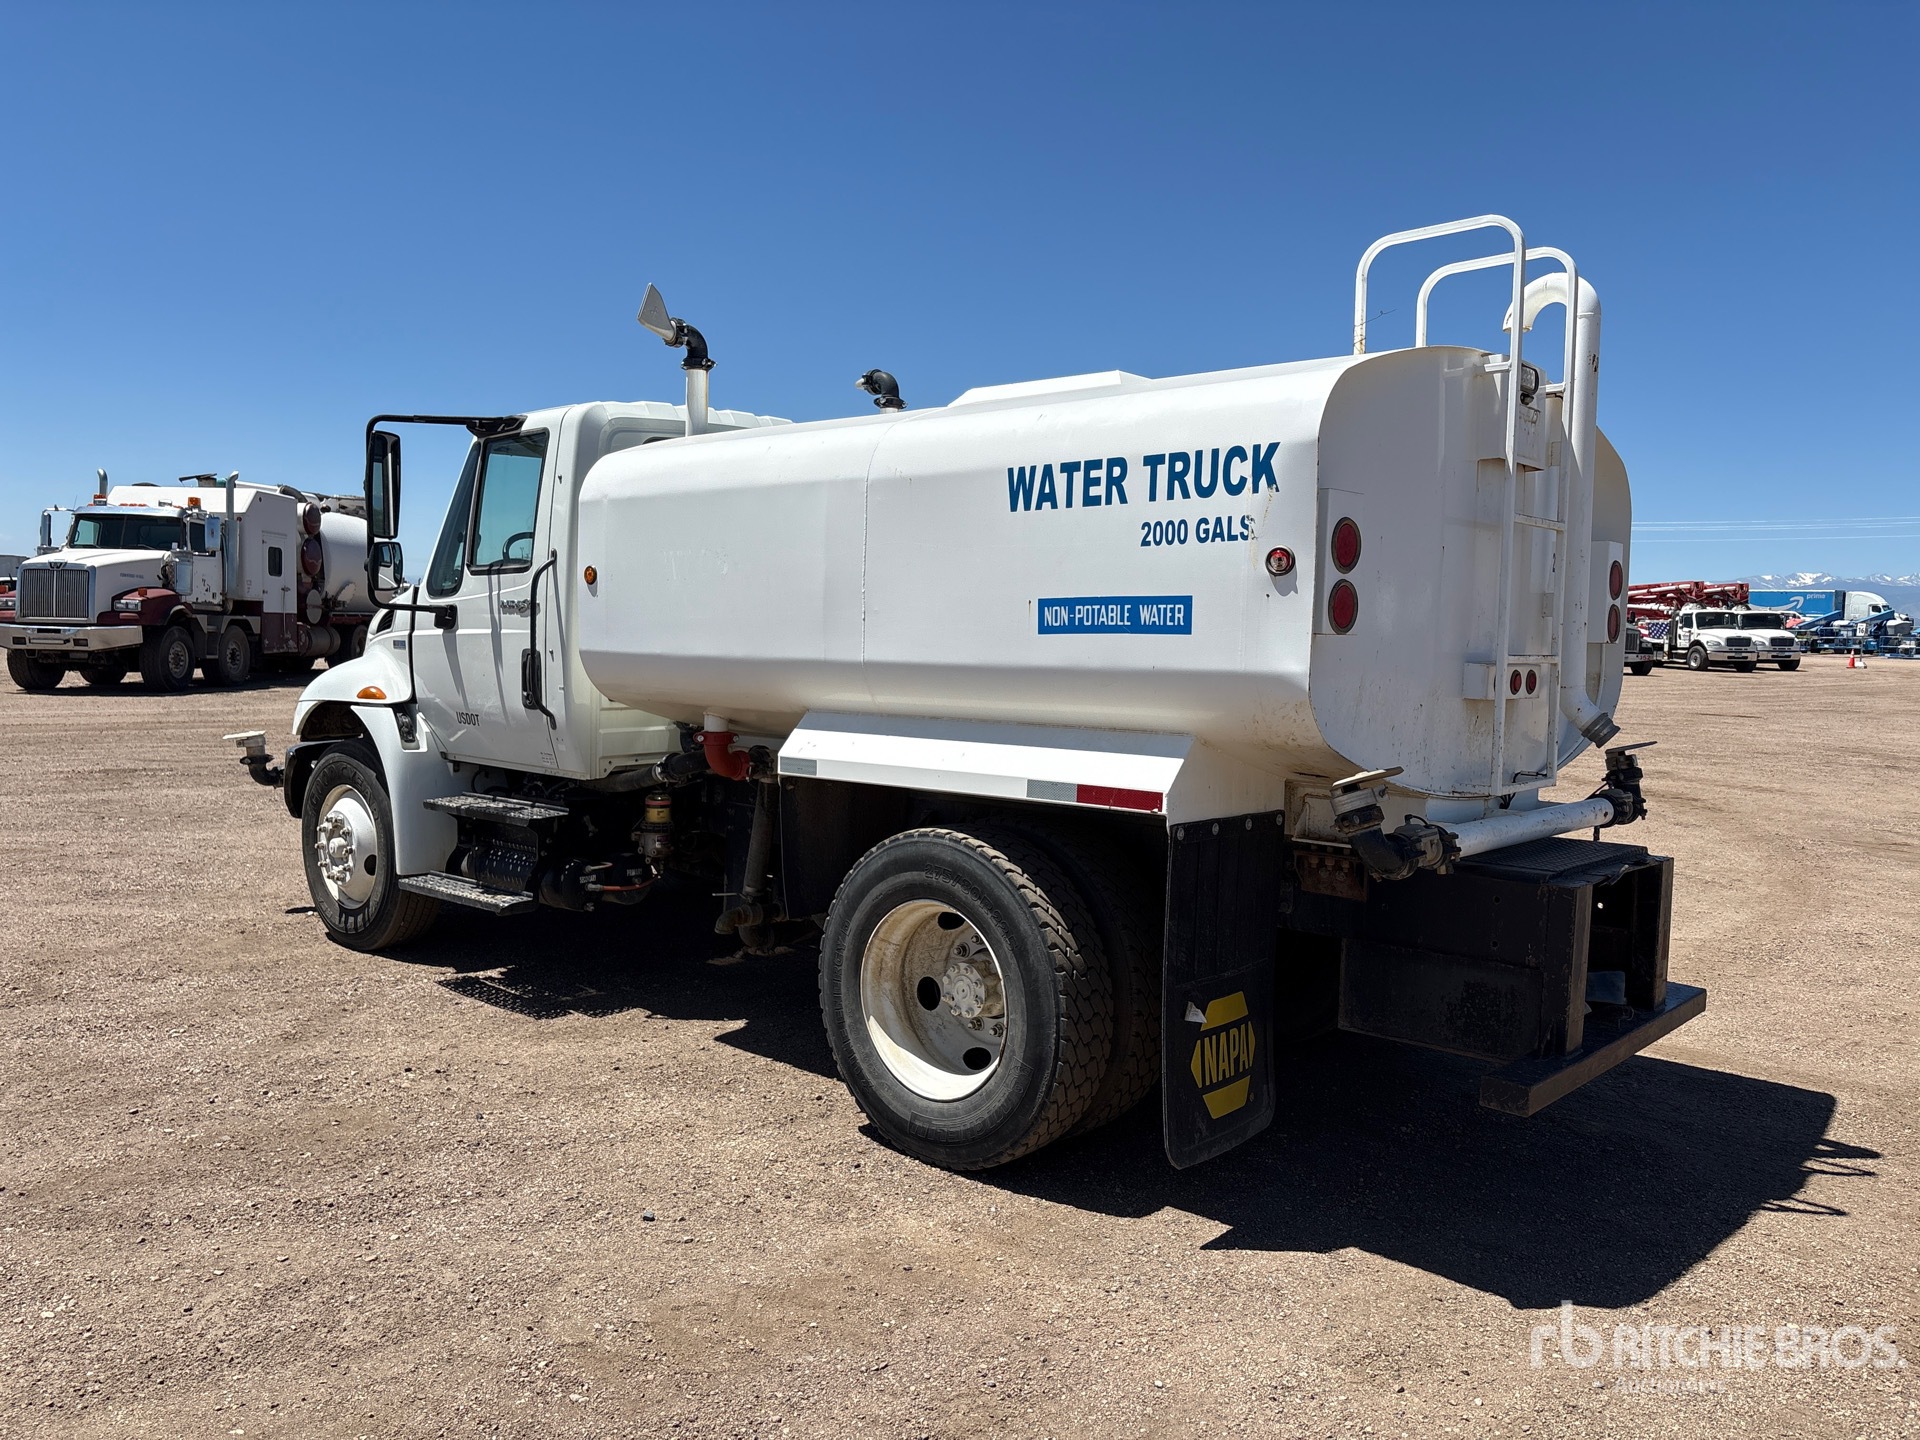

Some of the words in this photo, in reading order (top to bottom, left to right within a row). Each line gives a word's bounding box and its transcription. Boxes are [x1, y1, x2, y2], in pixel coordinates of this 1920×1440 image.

[1007, 456, 1128, 513] WATER
[1142, 441, 1281, 502] TRUCK
[1140, 518, 1188, 547] 2000
[1195, 514, 1253, 544] GALS
[1806, 592, 1826, 600] prime
[1044, 604, 1132, 627] NON-POTABLE
[1139, 603, 1185, 626] WATER
[455, 711, 480, 727] USDOT
[1204, 1023, 1250, 1086] NAPA
